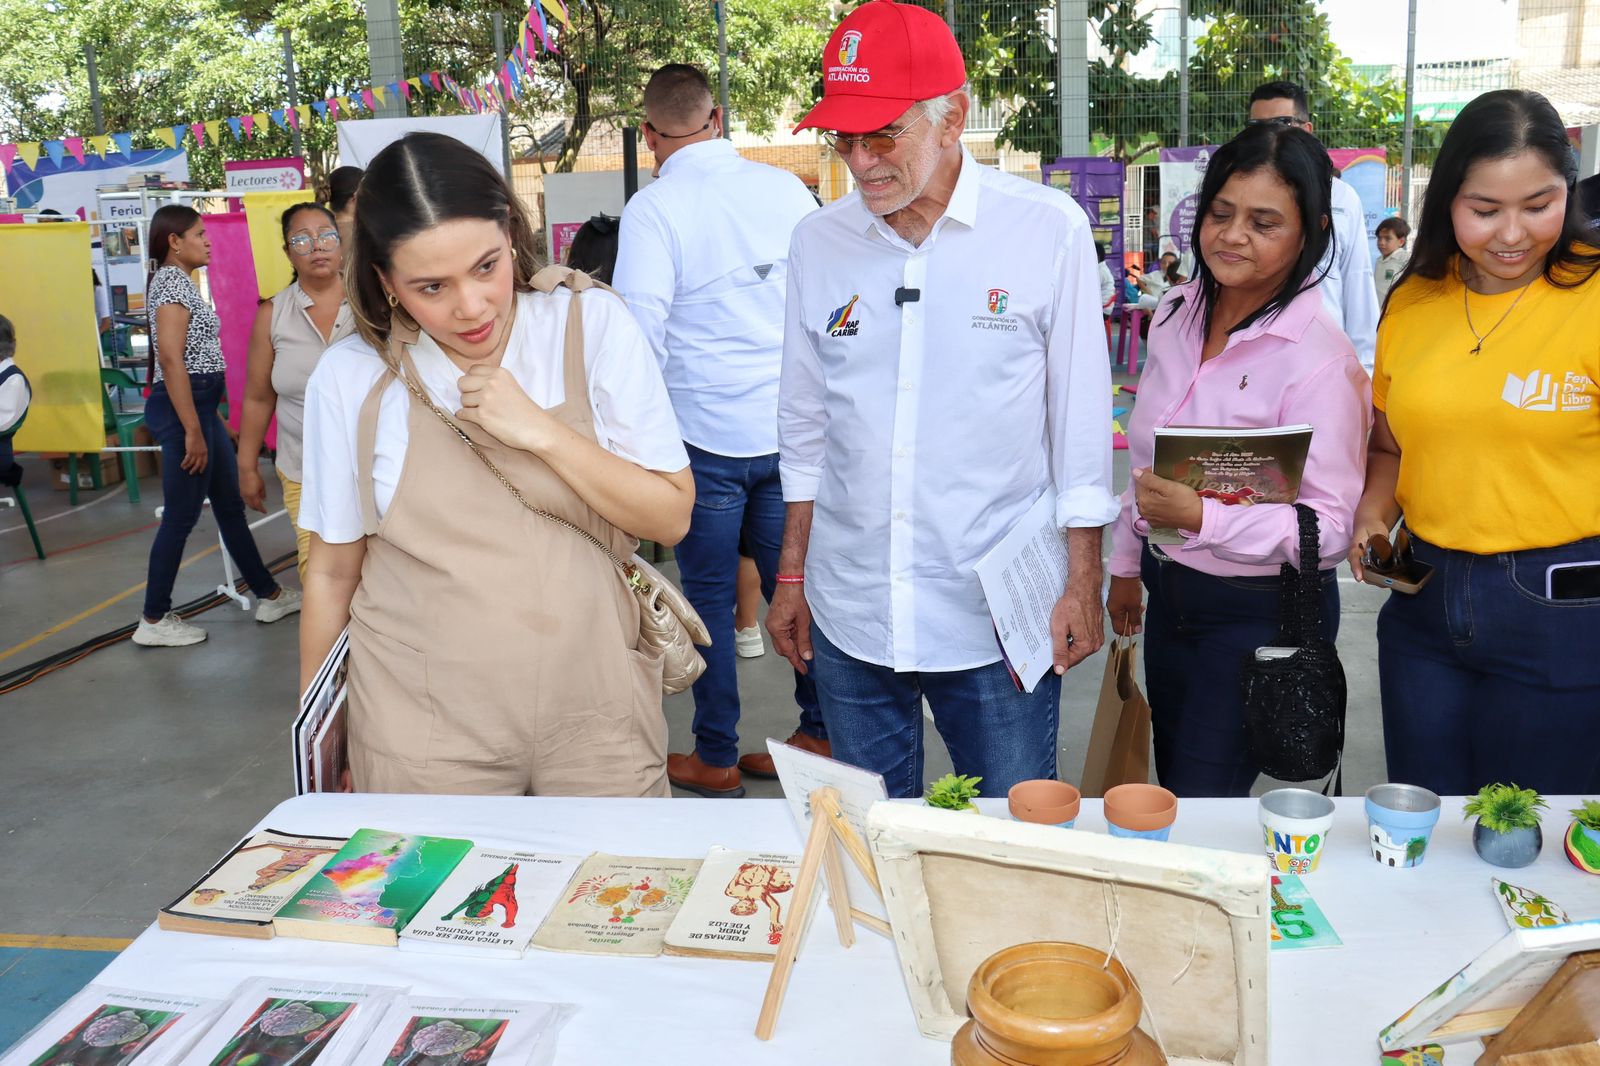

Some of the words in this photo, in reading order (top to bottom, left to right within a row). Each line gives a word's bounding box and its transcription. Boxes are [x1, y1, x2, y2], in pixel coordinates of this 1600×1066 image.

[828, 71, 870, 83] ATLÁNTICO
[230, 175, 278, 187] Lectores
[110, 204, 142, 217] Feria
[845, 320, 860, 329] RAP
[971, 321, 1018, 332] ATLÁNTICO
[831, 328, 859, 338] CARIBE
[1561, 393, 1592, 405] Libro
[320, 909, 361, 920] todos
[708, 920, 729, 928] LUZ
[718, 927, 749, 936] AMOR
[453, 934, 476, 942] DEBE
[703, 933, 746, 942] POEMAS
